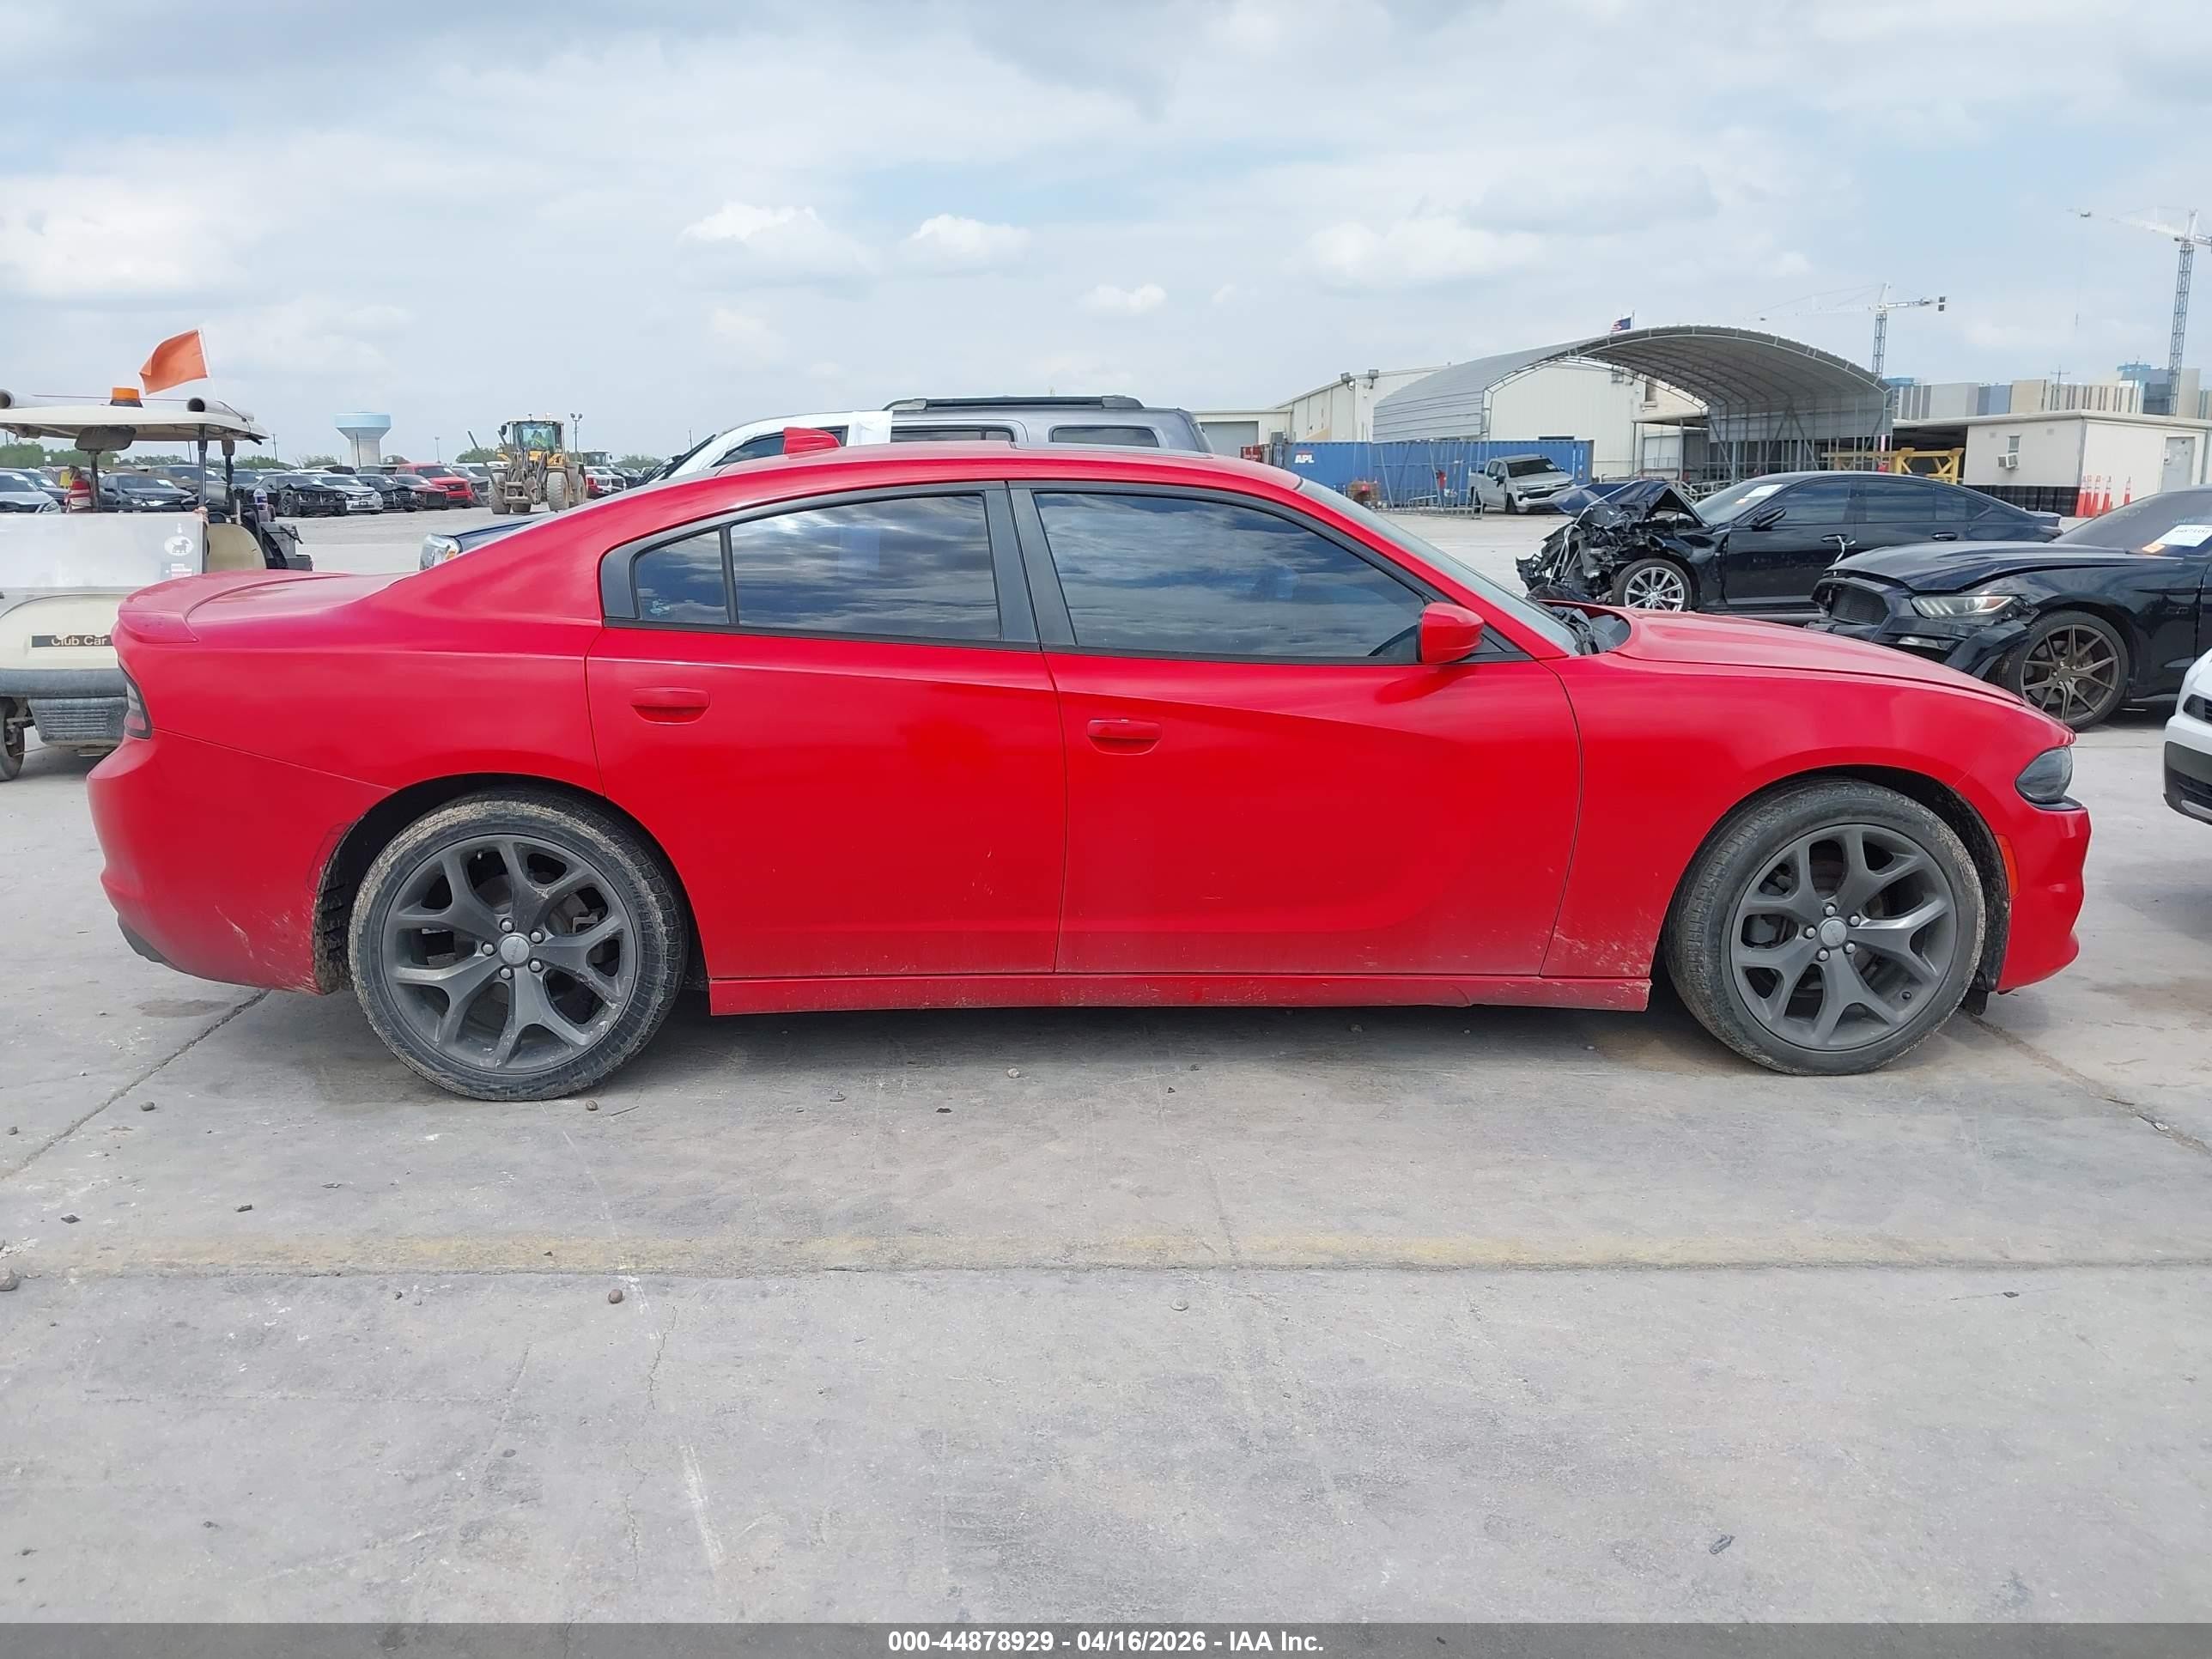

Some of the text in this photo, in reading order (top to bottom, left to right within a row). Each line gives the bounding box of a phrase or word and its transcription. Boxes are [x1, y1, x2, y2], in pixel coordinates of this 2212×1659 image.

[1294, 454, 1315, 464] APL
[52, 635, 107, 646] Club Car
